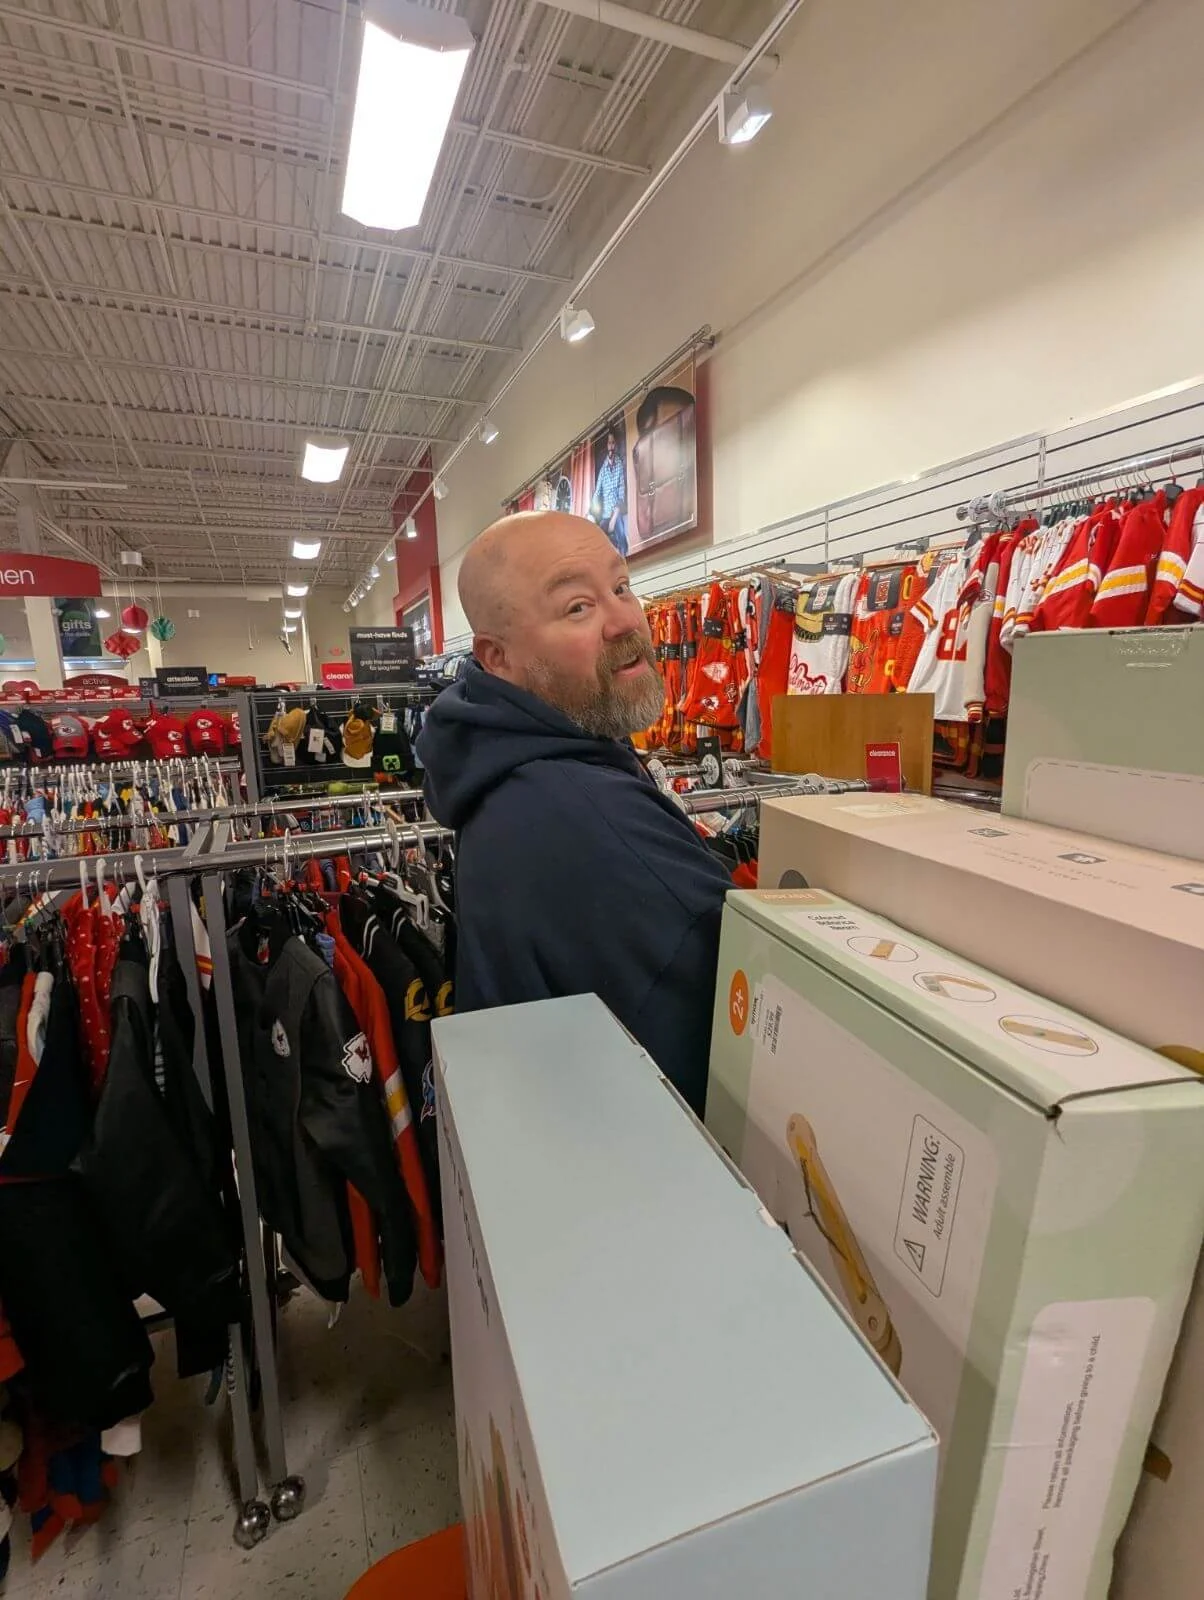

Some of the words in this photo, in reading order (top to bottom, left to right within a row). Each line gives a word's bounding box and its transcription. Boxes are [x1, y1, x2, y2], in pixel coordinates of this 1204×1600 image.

[62, 620, 92, 631] gifts
[356, 631, 391, 639] must-have
[733, 988, 744, 1021] 2+
[912, 1135, 941, 1225] WARNING:
[933, 1207, 947, 1240] Adult
[940, 1153, 956, 1208] assemble
[1085, 1363, 1094, 1373] to
[1080, 1373, 1093, 1398] giving
